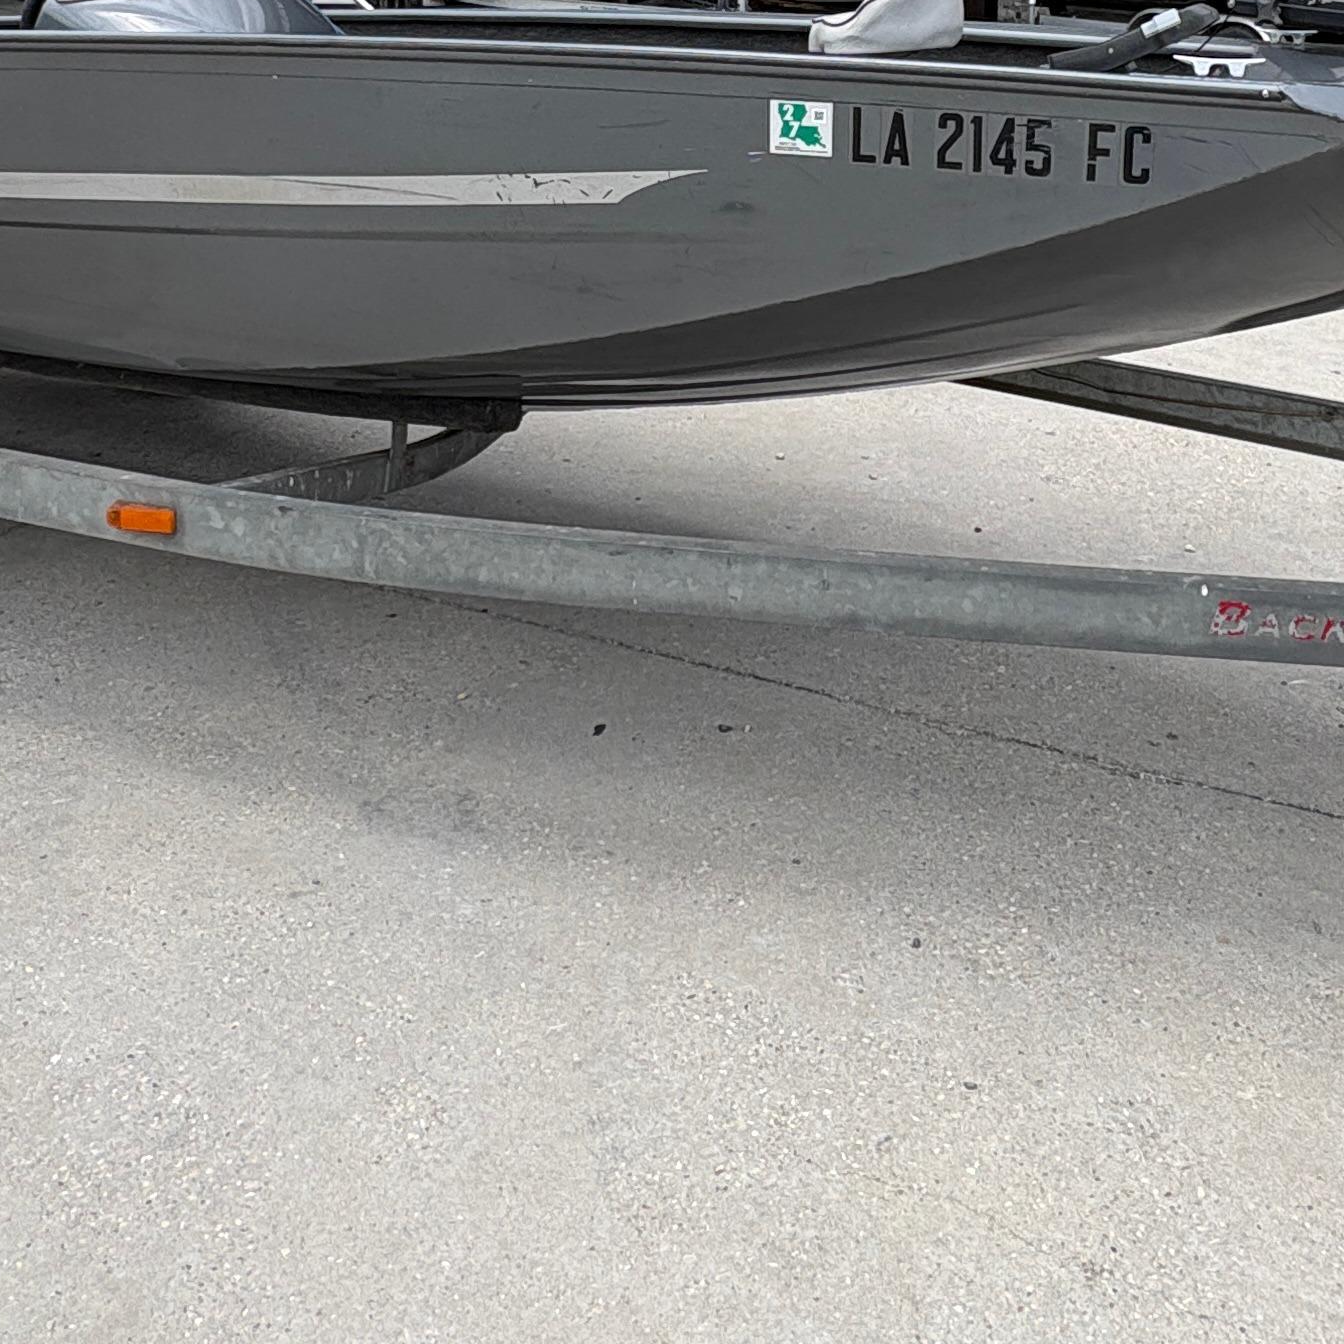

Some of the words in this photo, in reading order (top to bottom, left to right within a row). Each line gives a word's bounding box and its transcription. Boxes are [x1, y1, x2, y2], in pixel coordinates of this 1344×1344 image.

[782, 104, 794, 121] 2
[788, 121, 801, 138] 7
[852, 107, 910, 166] LA
[936, 112, 1053, 177] 2145
[1086, 122, 1152, 184] FC
